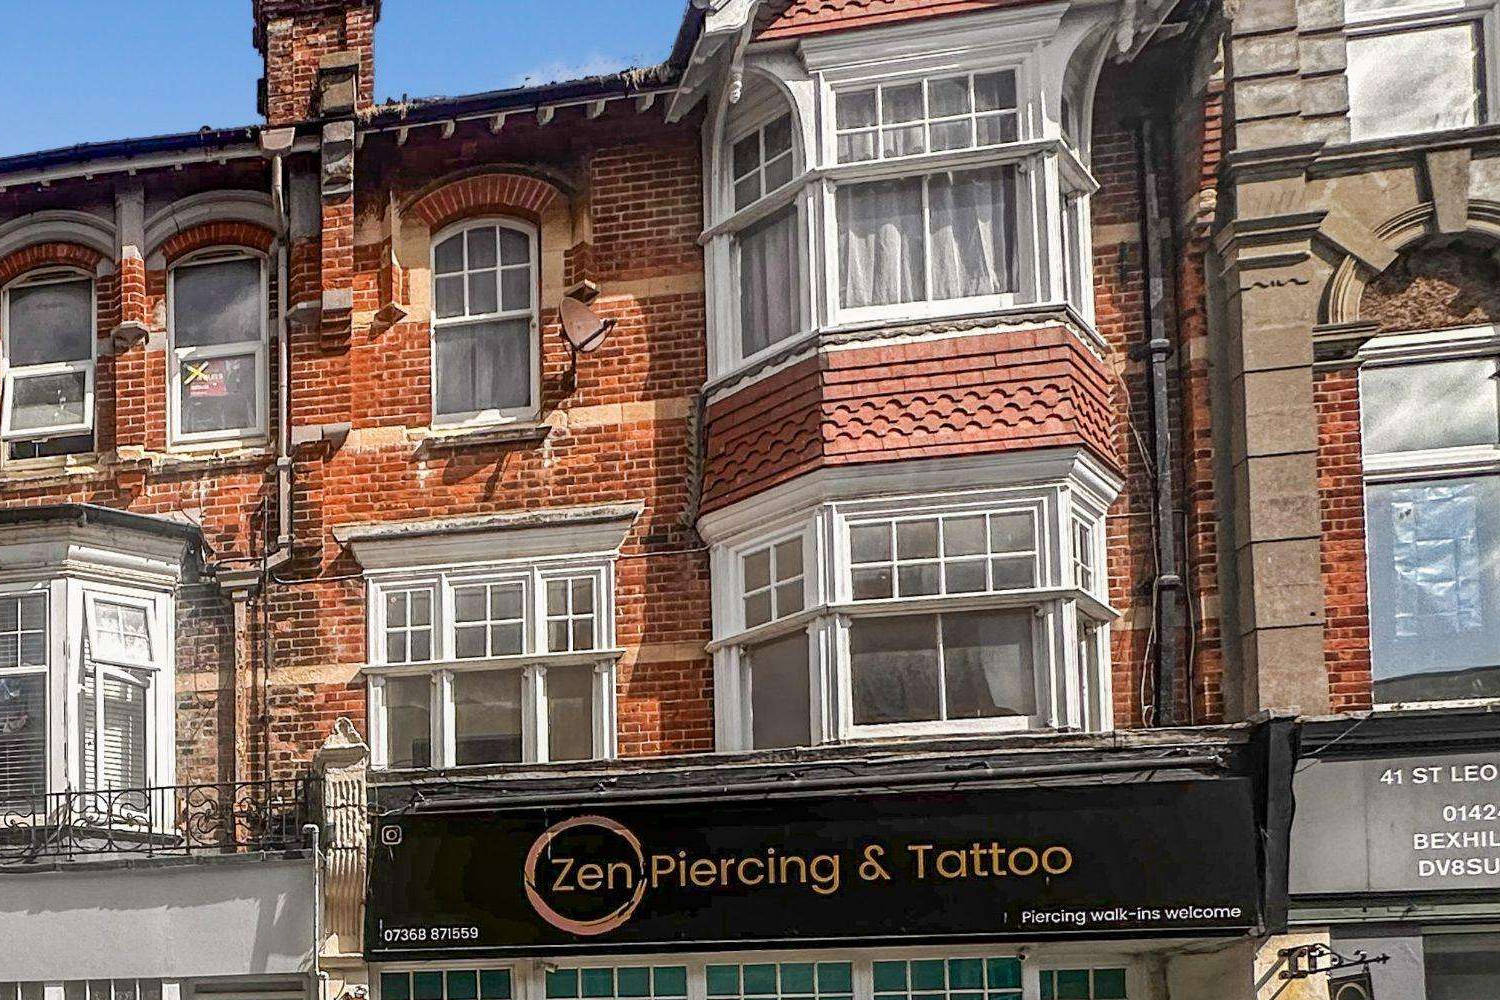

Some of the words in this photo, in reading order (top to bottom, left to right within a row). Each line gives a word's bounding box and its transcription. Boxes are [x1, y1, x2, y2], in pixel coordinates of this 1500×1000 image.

[1380, 769, 1402, 785] 41
[1412, 767, 1443, 784] ST
[1451, 764, 1498, 782] LEO
[1443, 804, 1500, 821] 0142
[1414, 831, 1500, 850] BEXHIL
[552, 858, 632, 891] Zen
[651, 850, 840, 894] Piercing
[859, 844, 891, 881] &
[907, 842, 1073, 879] Tattoo
[1418, 858, 1500, 877] DV8SU
[1022, 909, 1086, 926] Piercing
[1090, 906, 1161, 922] walk-ins
[1164, 905, 1242, 920] welcome
[384, 928, 427, 942] 07368
[430, 926, 479, 941] 871559
